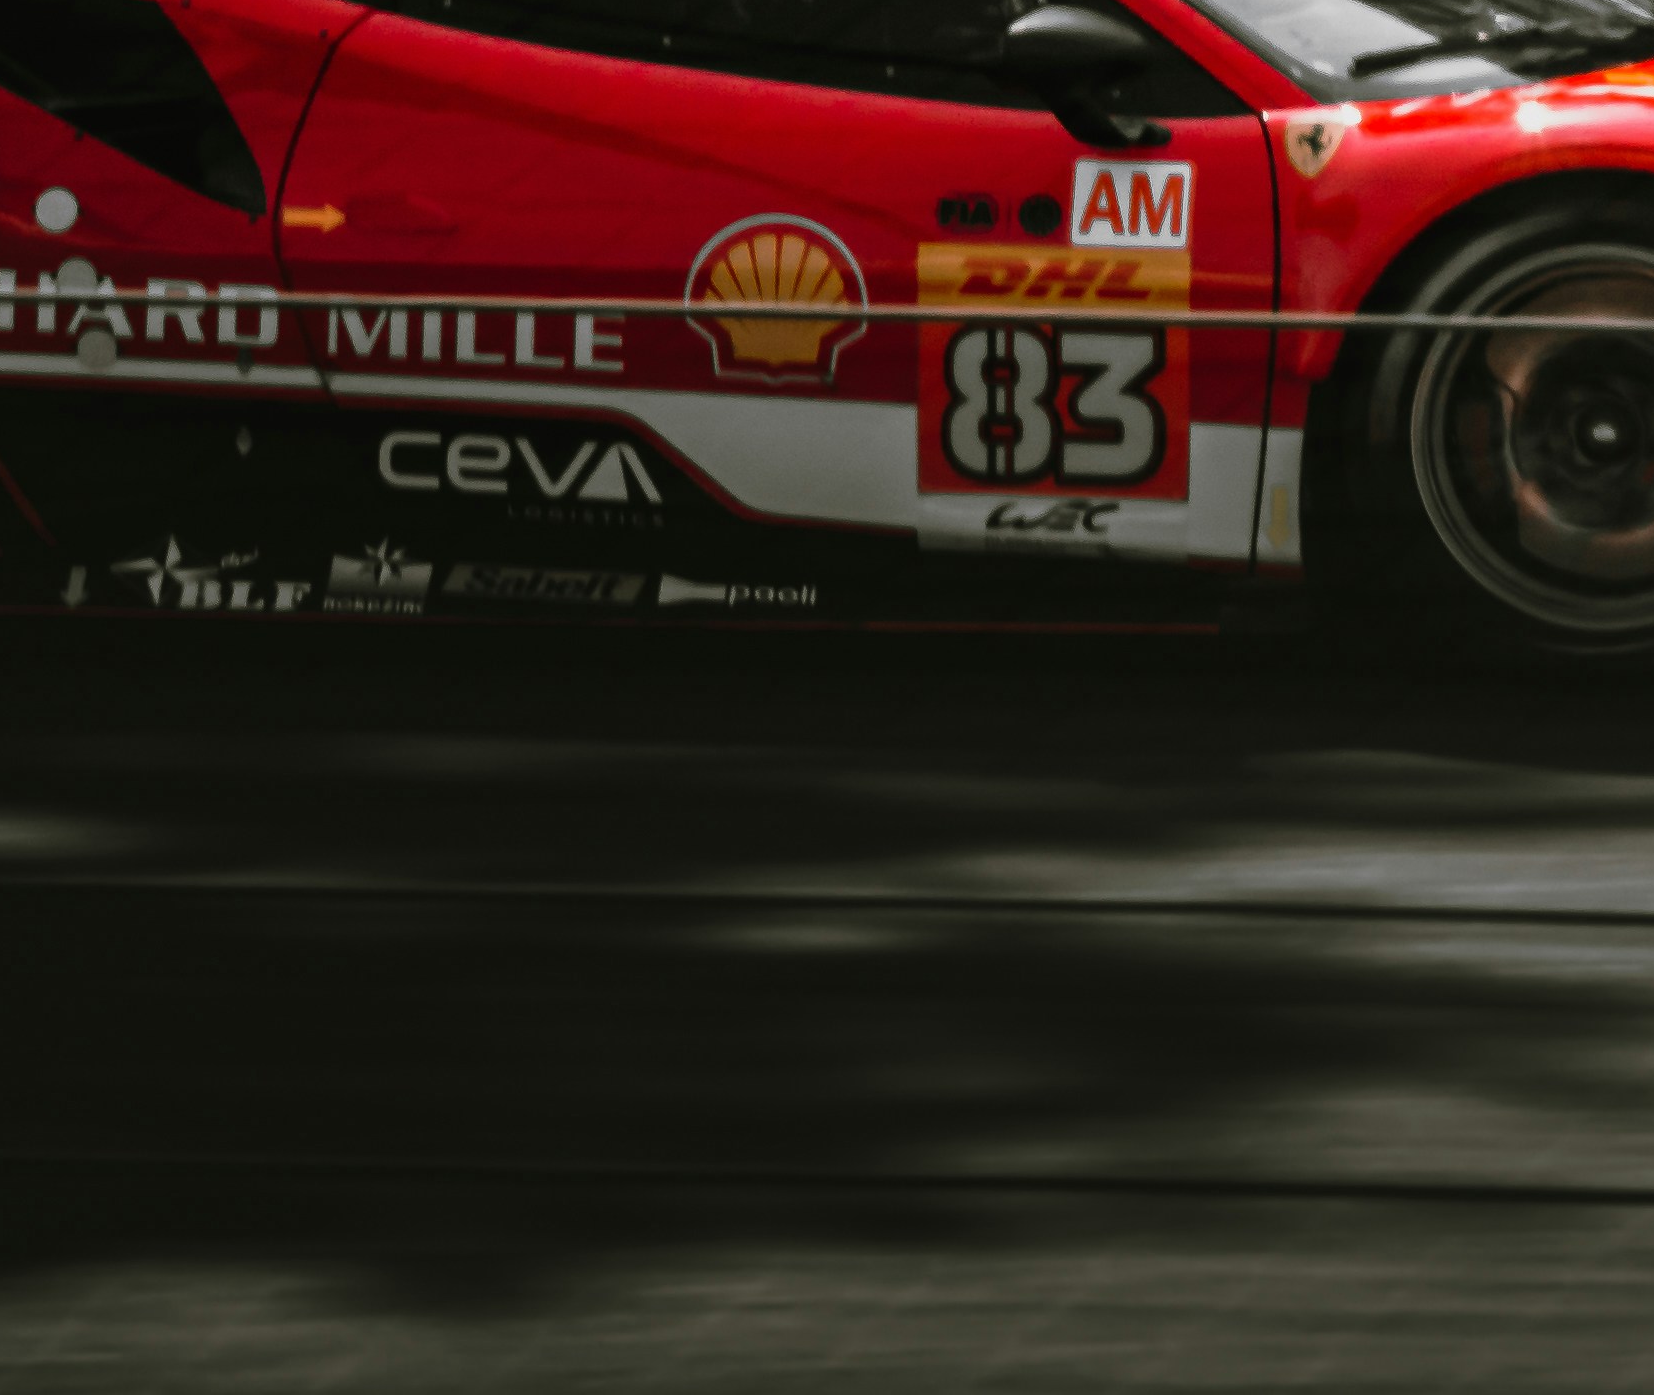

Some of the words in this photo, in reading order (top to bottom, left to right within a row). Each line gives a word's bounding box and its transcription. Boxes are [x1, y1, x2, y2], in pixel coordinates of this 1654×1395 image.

[1078, 168, 1186, 238] AM
[958, 258, 1152, 300] DHL
[327, 300, 625, 372] MILLE
[942, 322, 1168, 487] 83
